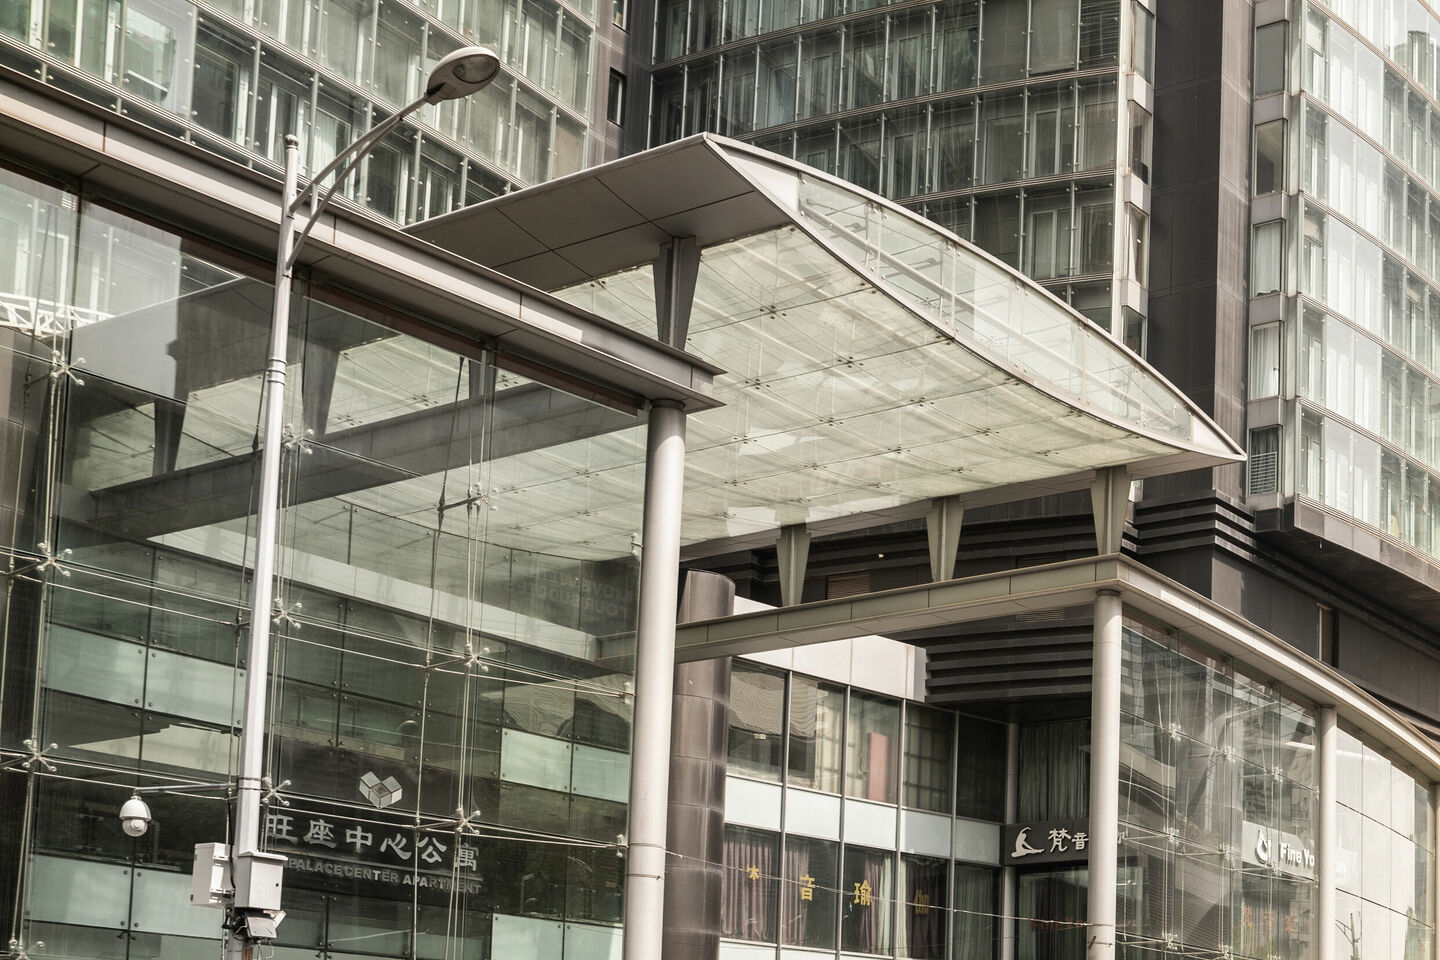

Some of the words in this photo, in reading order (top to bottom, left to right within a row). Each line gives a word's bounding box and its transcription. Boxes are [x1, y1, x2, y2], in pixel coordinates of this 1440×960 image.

[266, 813, 480, 872] 旺座中心公寓
[1280, 843, 1301, 863] Fine
[403, 875, 482, 895] APARTMENT
